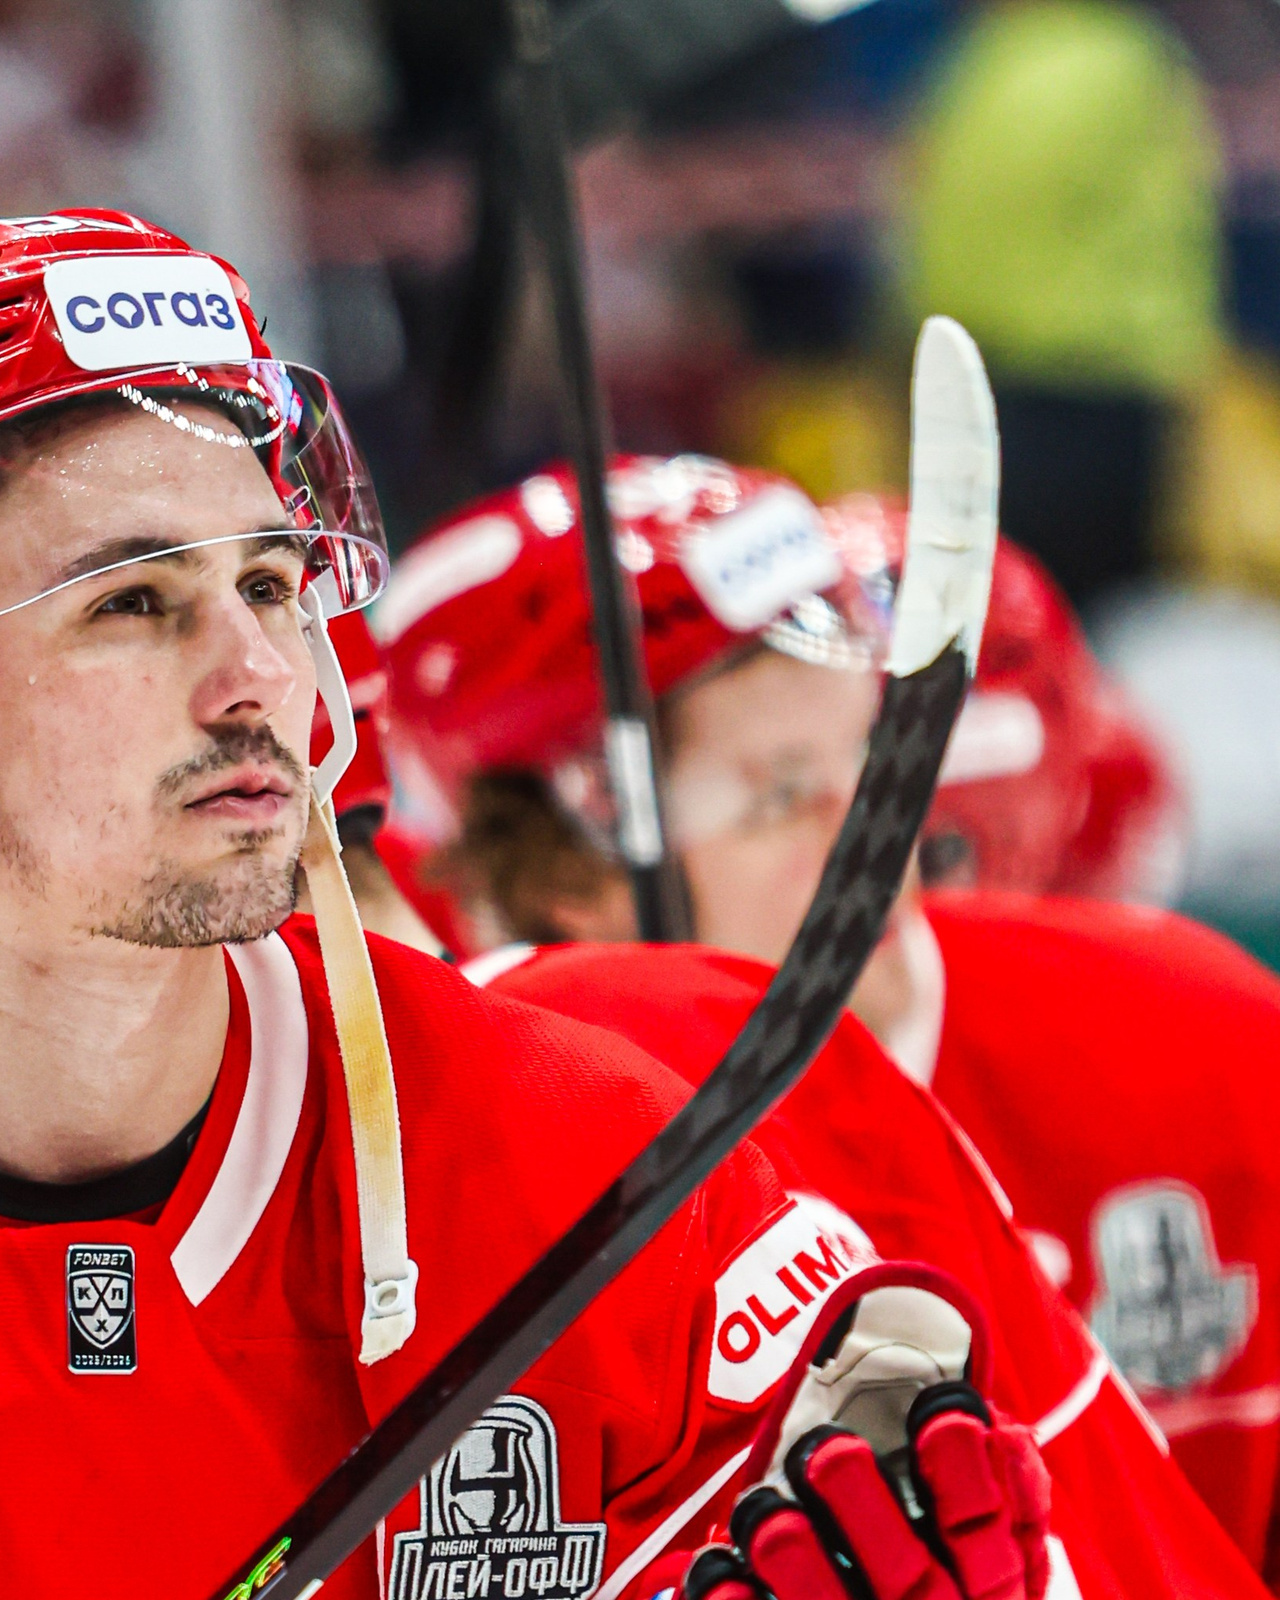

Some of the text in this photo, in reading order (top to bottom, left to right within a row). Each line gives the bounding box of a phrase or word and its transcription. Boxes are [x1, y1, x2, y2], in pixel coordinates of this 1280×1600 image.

[73, 1252, 128, 1266] FONBET
[75, 1354, 131, 1366] 2025/2026
[430, 1536, 558, 1557] КУБОК ГАГАРИНА
